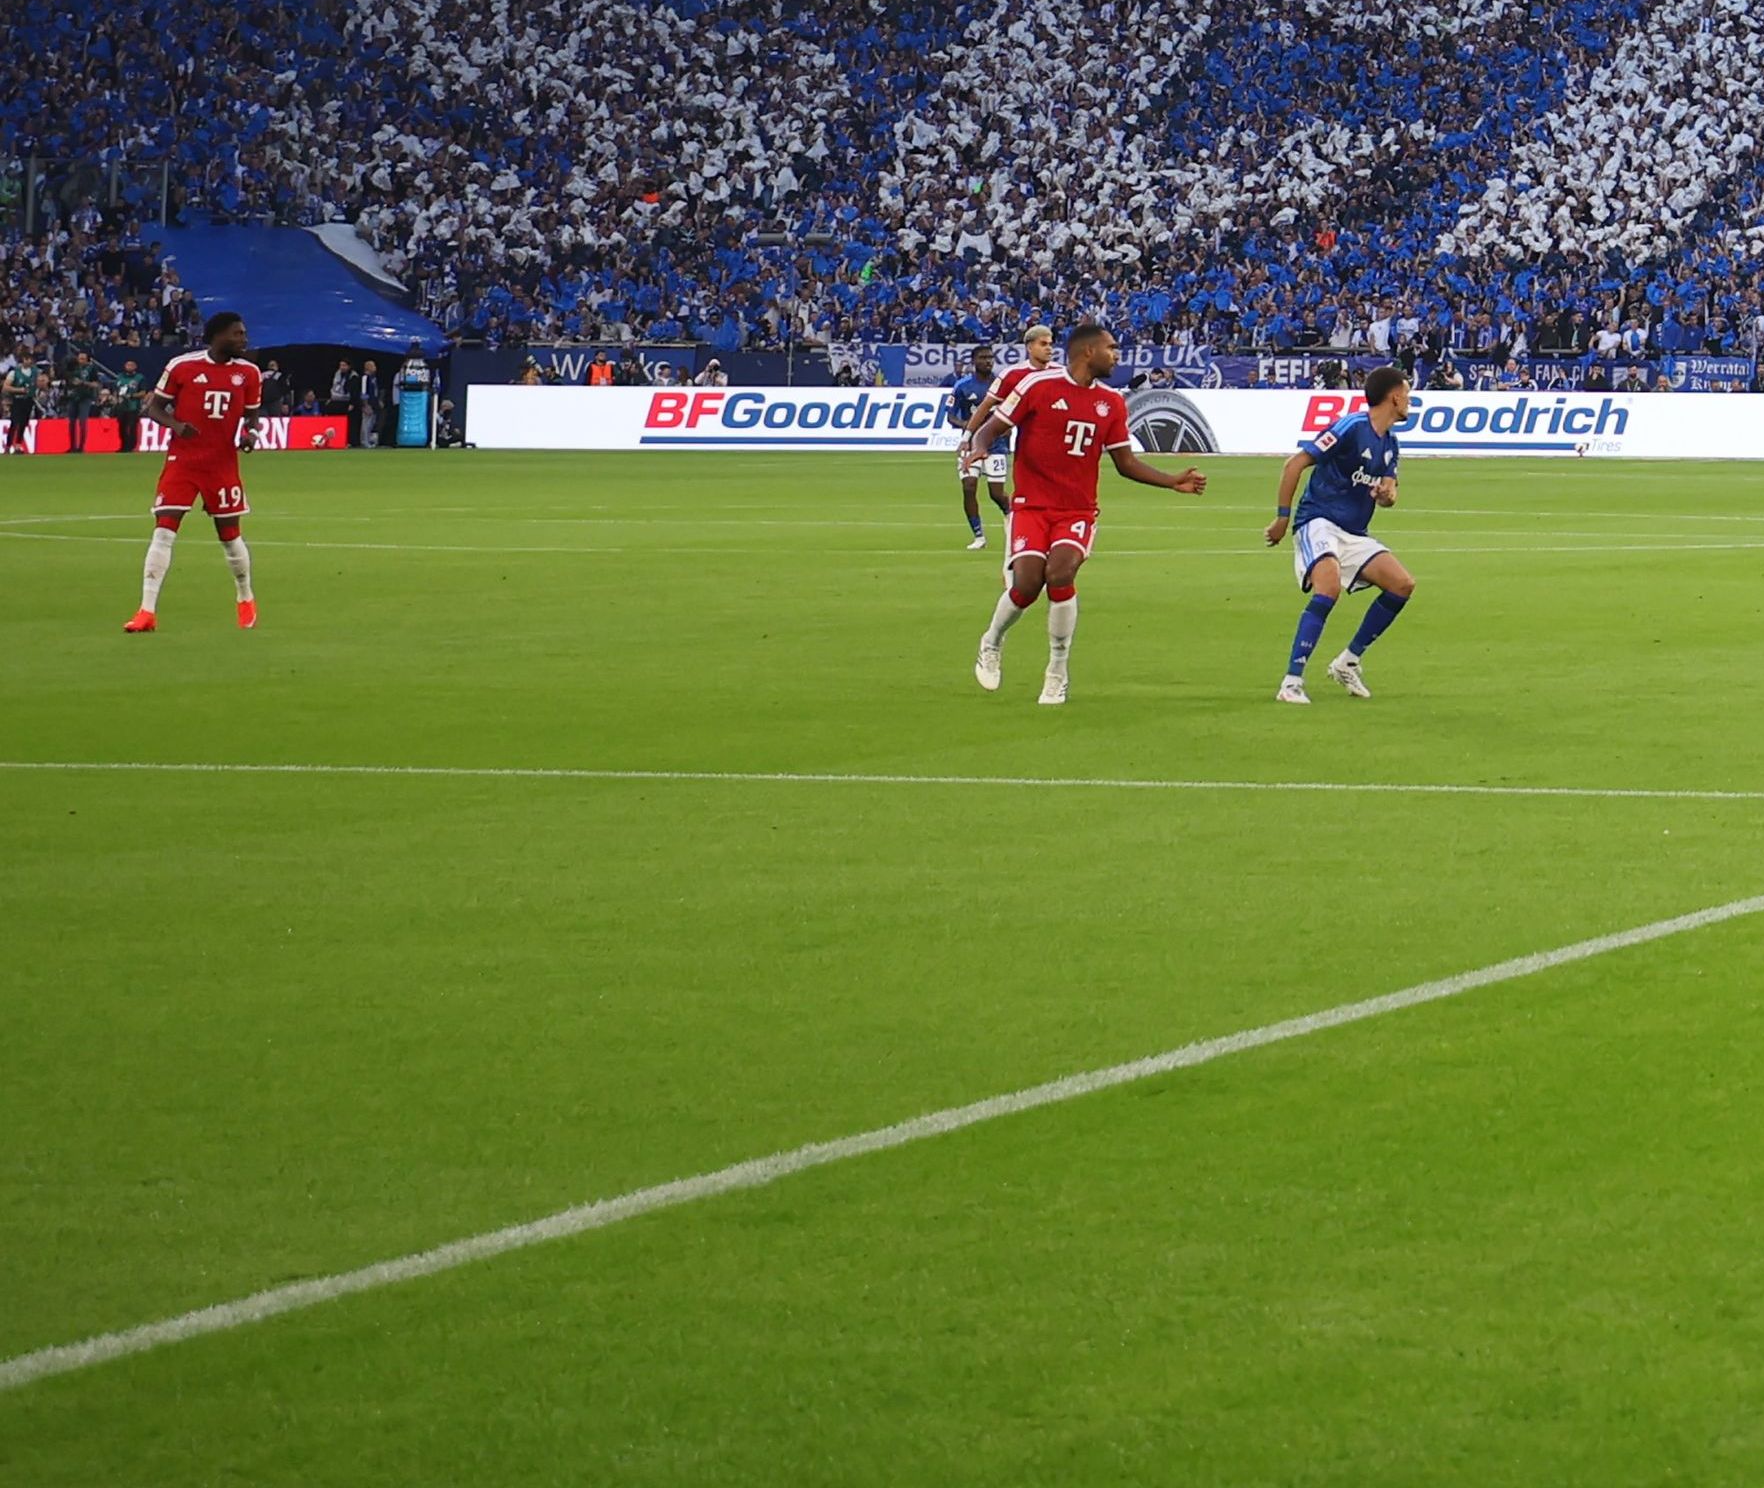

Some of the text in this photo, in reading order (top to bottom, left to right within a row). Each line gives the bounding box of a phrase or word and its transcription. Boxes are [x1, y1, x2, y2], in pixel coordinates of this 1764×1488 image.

[1163, 341, 1206, 368] UK
[218, 486, 242, 509] 19
[1070, 519, 1087, 540] 4
